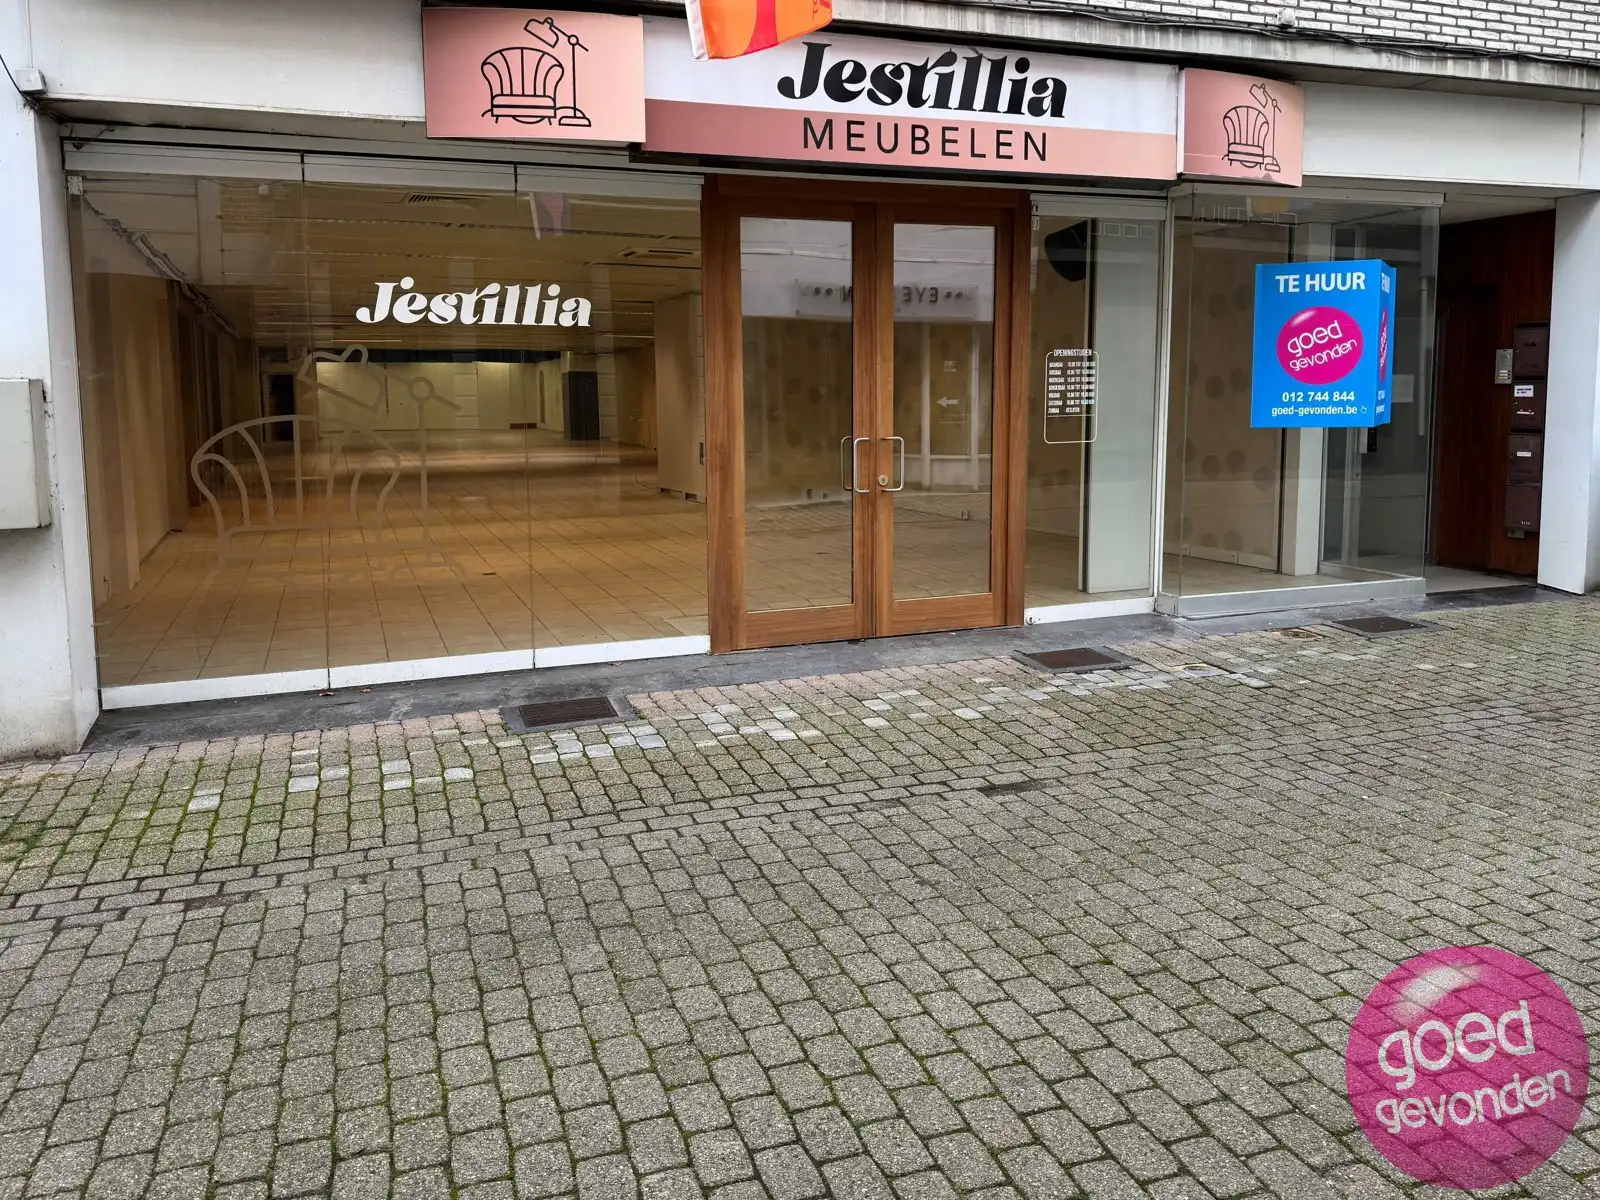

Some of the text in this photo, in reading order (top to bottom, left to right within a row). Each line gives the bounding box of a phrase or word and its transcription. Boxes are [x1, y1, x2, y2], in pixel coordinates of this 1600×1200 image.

[777, 41, 1067, 118] Jestillia
[803, 117, 1047, 162] MEUBELEN
[1275, 274, 1300, 293] TE
[1305, 271, 1366, 292] HUUR
[355, 276, 592, 327] Jestillia
[1287, 320, 1343, 357] goed
[1289, 338, 1358, 371] gevonden
[1271, 404, 1358, 417] goed-gevonden.be
[1282, 391, 1355, 402] 012 744 844
